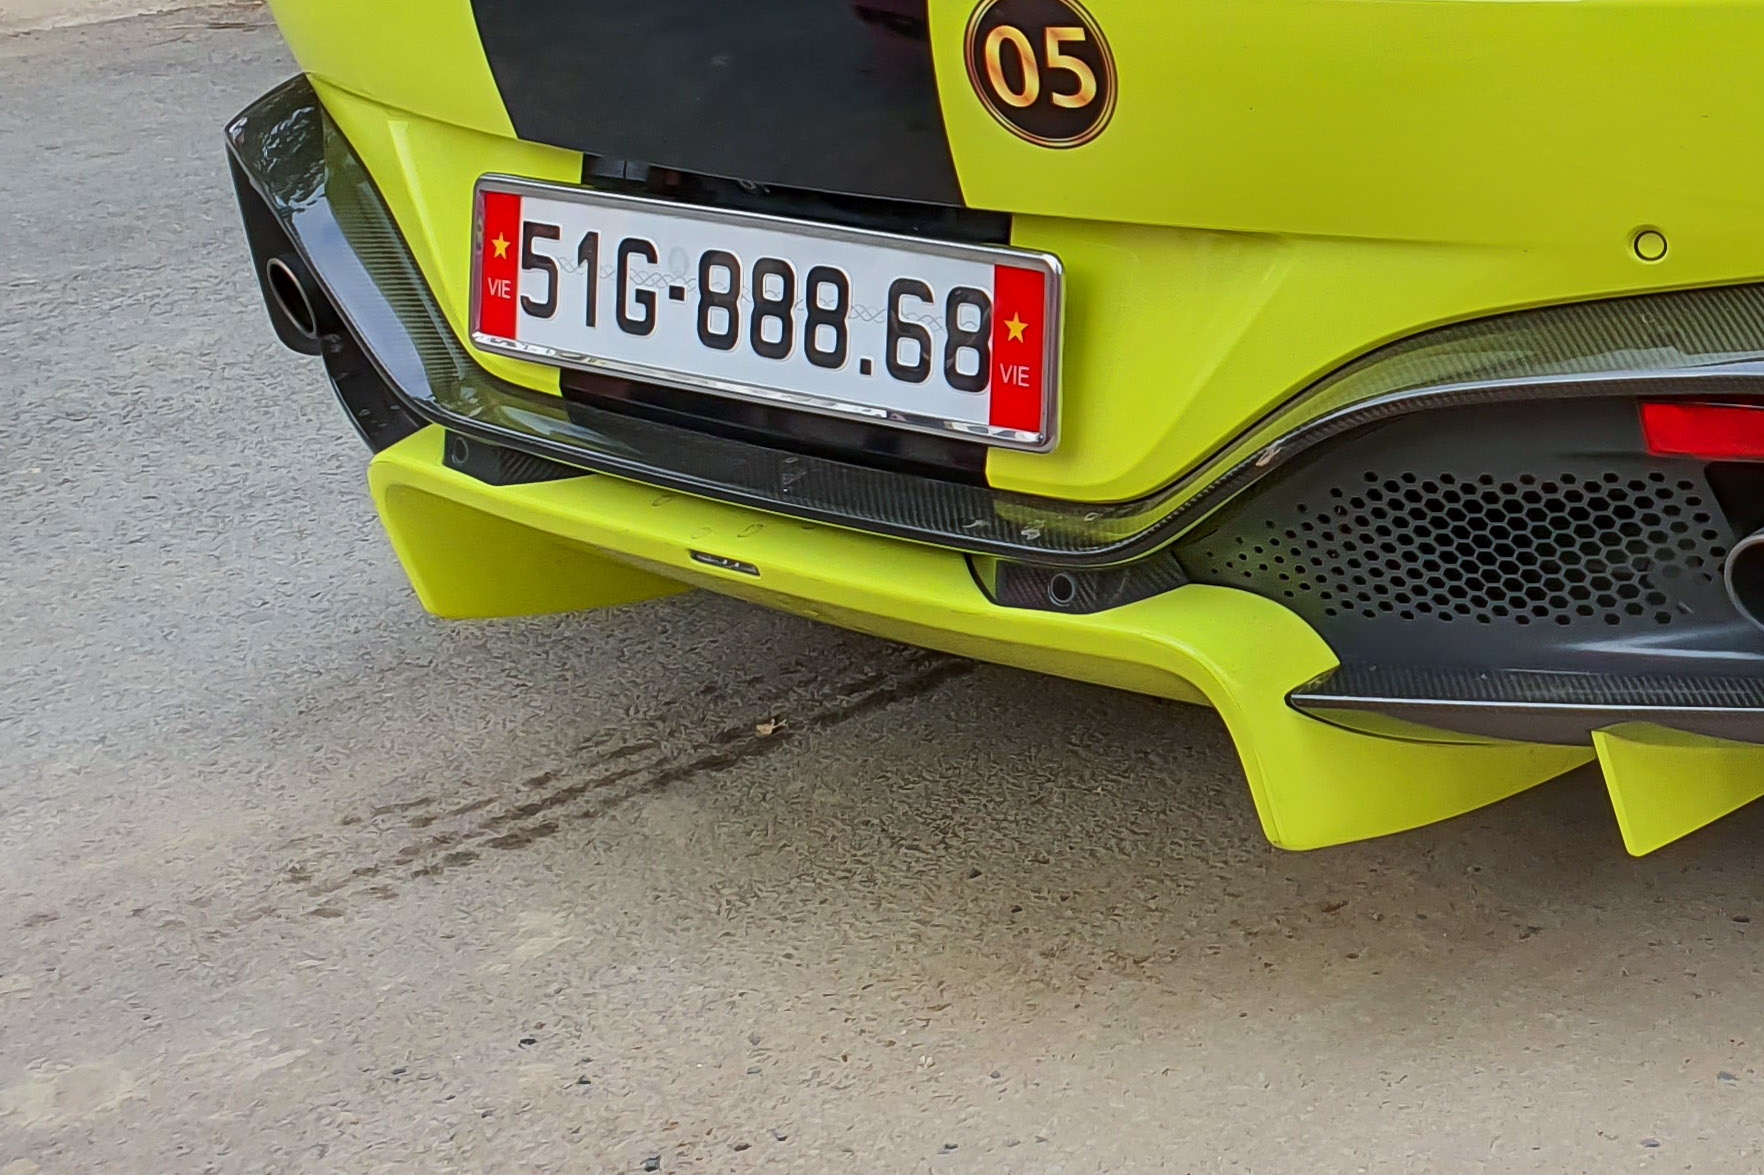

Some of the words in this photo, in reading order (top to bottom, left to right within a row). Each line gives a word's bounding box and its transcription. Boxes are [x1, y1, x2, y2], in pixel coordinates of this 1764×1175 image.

[984, 24, 1097, 109] 05
[487, 277, 512, 300] VIE
[519, 221, 994, 394] 51G-888.68
[999, 362, 1031, 388] VIE
